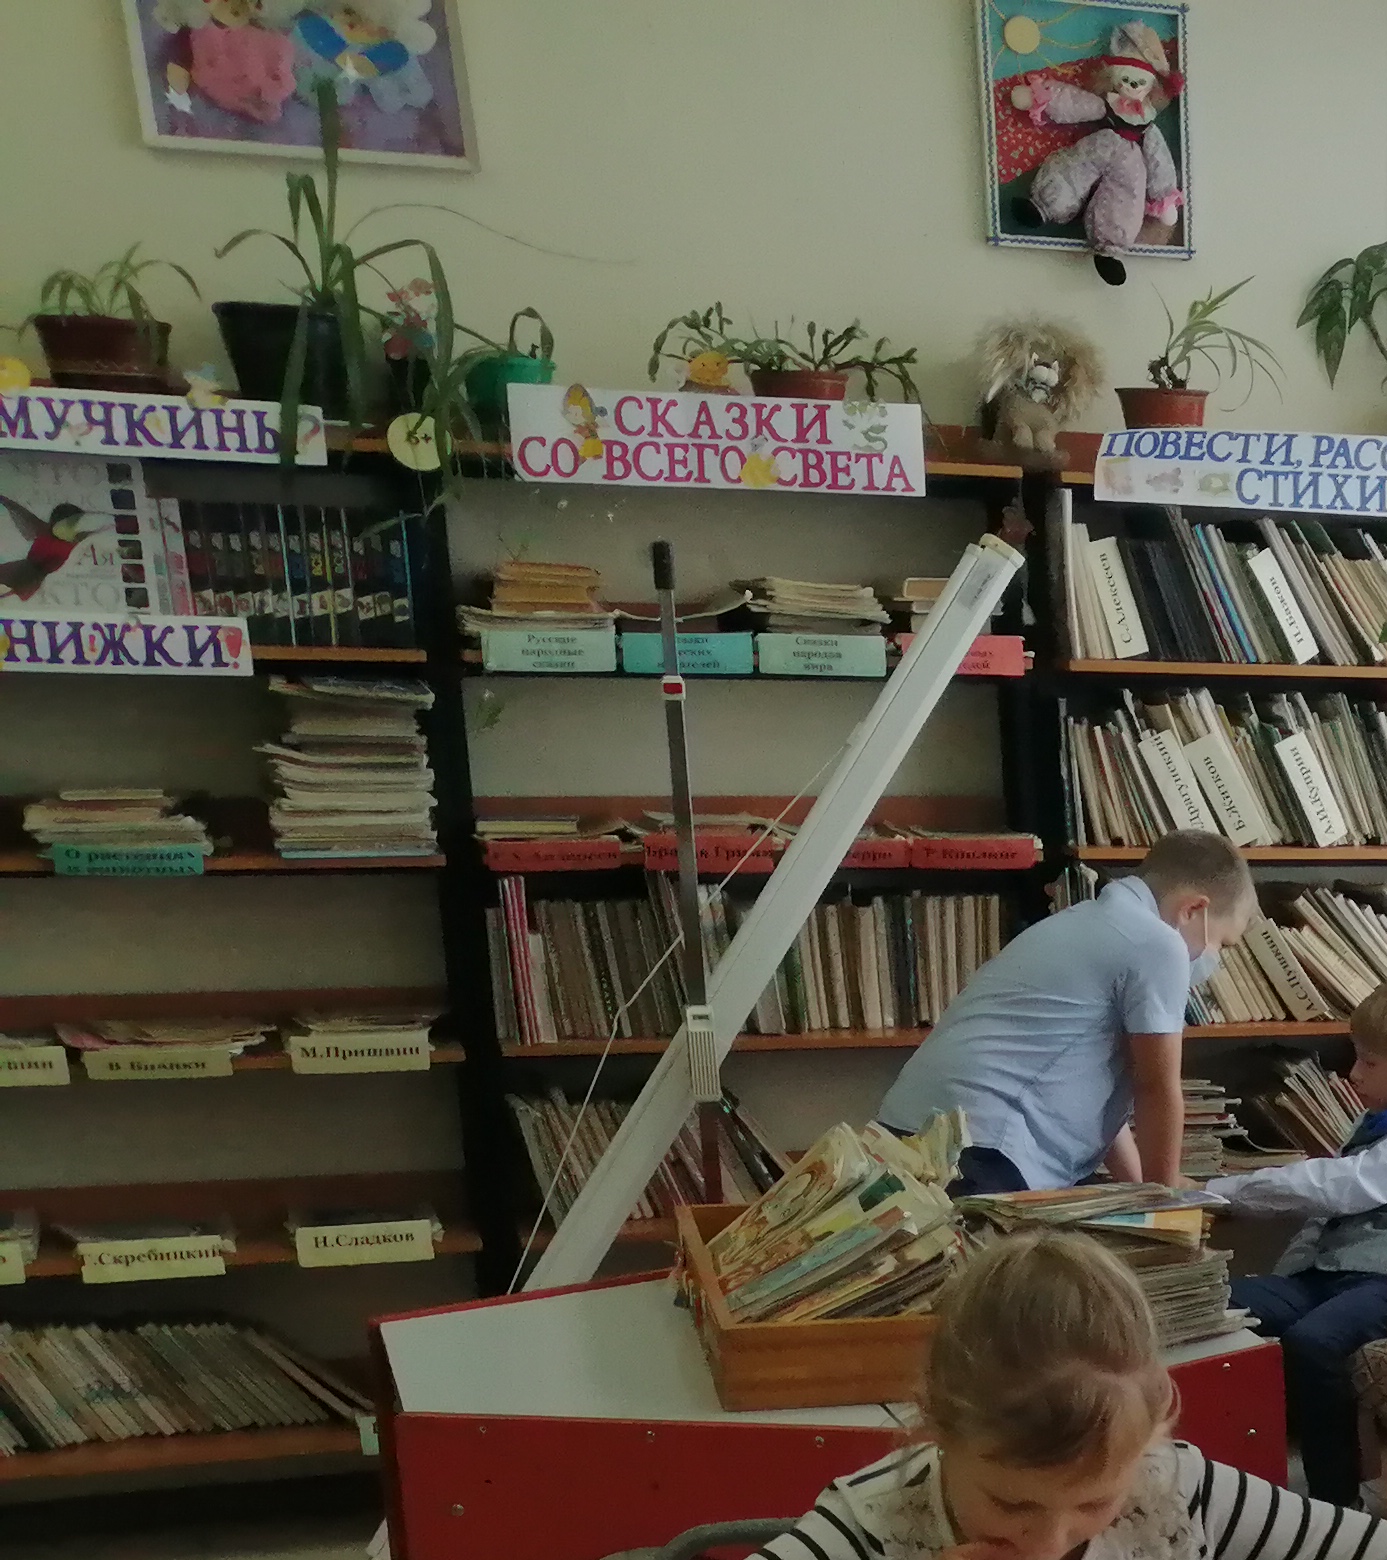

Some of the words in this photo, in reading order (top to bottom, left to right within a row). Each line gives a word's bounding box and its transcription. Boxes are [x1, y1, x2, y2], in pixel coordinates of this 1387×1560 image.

[613, 396, 832, 444] СКАЗКИ
[517, 436, 580, 477] СО
[602, 439, 747, 483] ВСЕГО
[774, 446, 917, 492] СВЕТА
[1101, 430, 1301, 469] ПОВЕСТИ,
[1100, 552, 1133, 644] С.Алексеев
[1269, 576, 1305, 646] П.Бажов
[521, 647, 585, 658] народные
[527, 634, 578, 645] Русские
[795, 636, 838, 647] Сказки
[532, 660, 575, 670] сказки
[793, 650, 842, 662] народов
[803, 664, 833, 674] мира
[1153, 735, 1205, 831] .Драгунский
[1204, 756, 1246, 832] Б.Житков
[1291, 747, 1335, 836] А.И.Куприн
[300, 1044, 421, 1062] М.Пришвин
[312, 1231, 416, 1250] Н.Сладков
